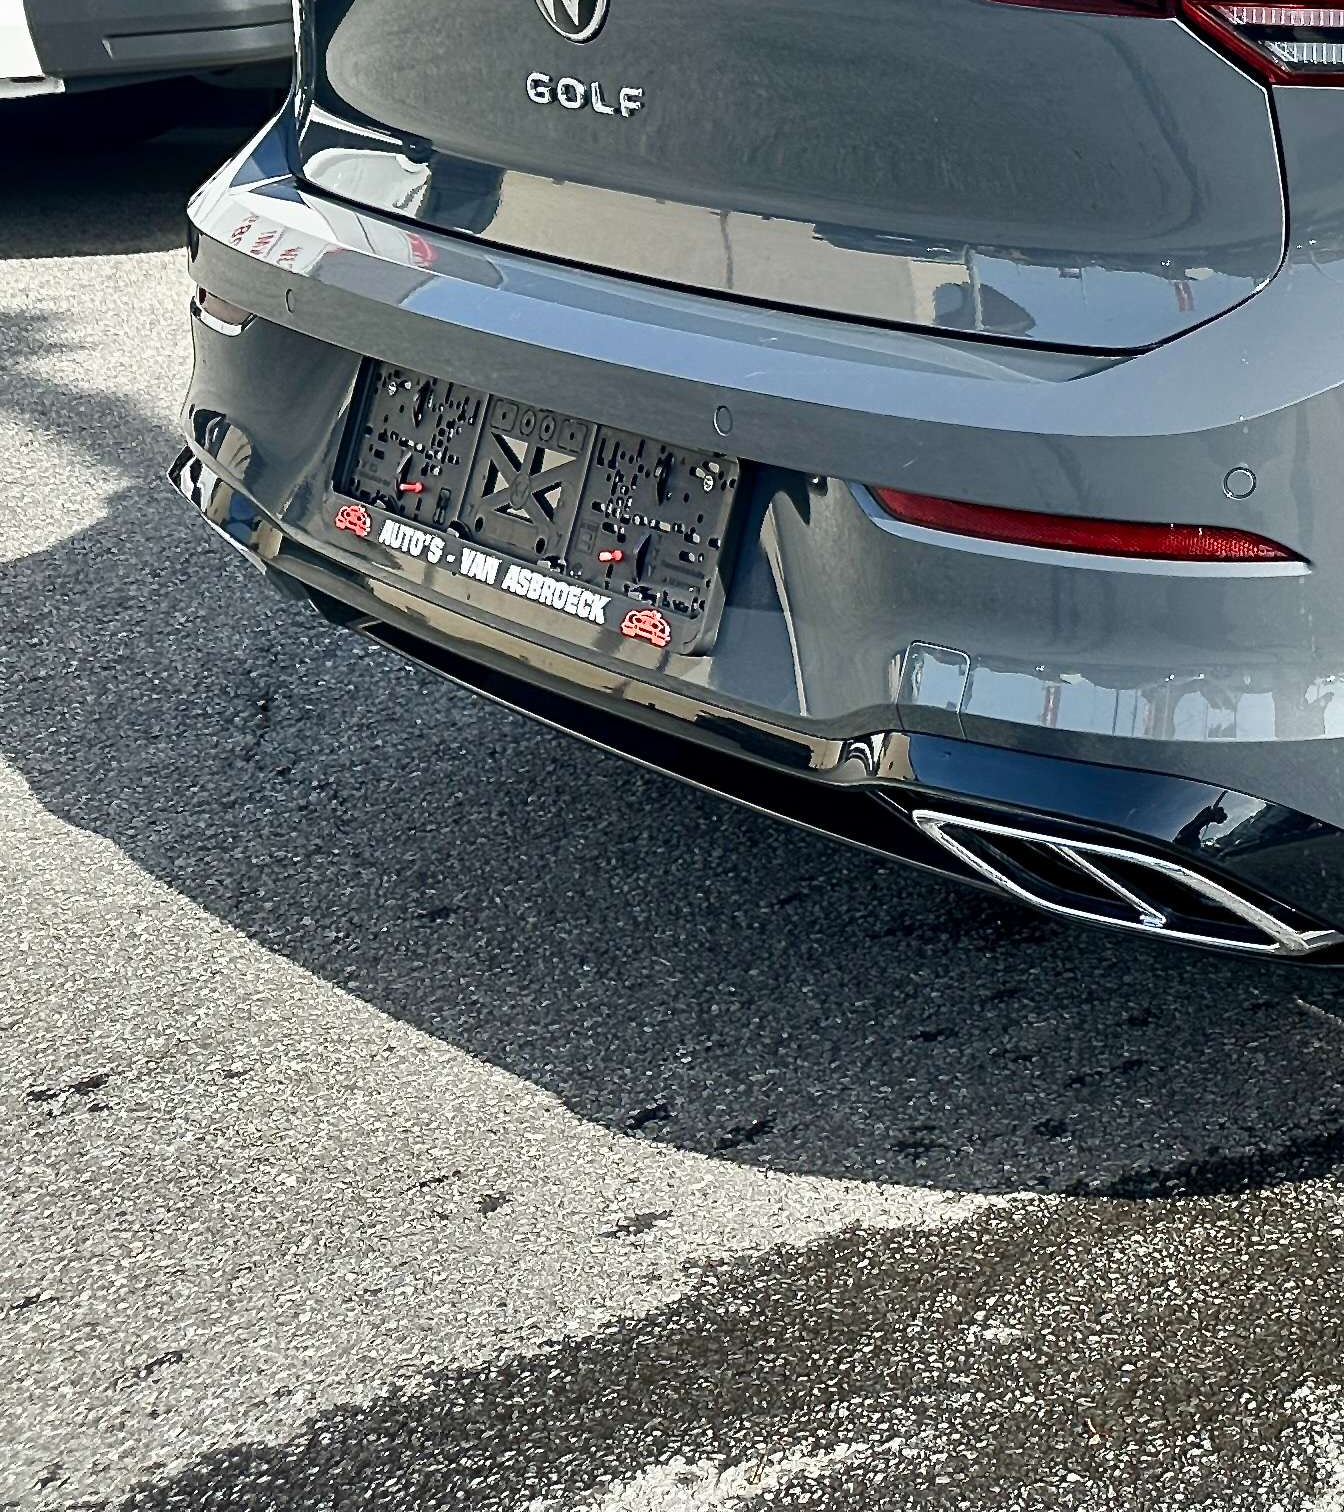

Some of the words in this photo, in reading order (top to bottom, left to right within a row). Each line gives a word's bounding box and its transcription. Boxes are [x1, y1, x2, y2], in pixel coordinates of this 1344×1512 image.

[526, 71, 644, 118] GOLF
[378, 519, 446, 565] AUTO'S
[459, 547, 502, 585] VAN
[501, 564, 612, 625] ASBROECK
